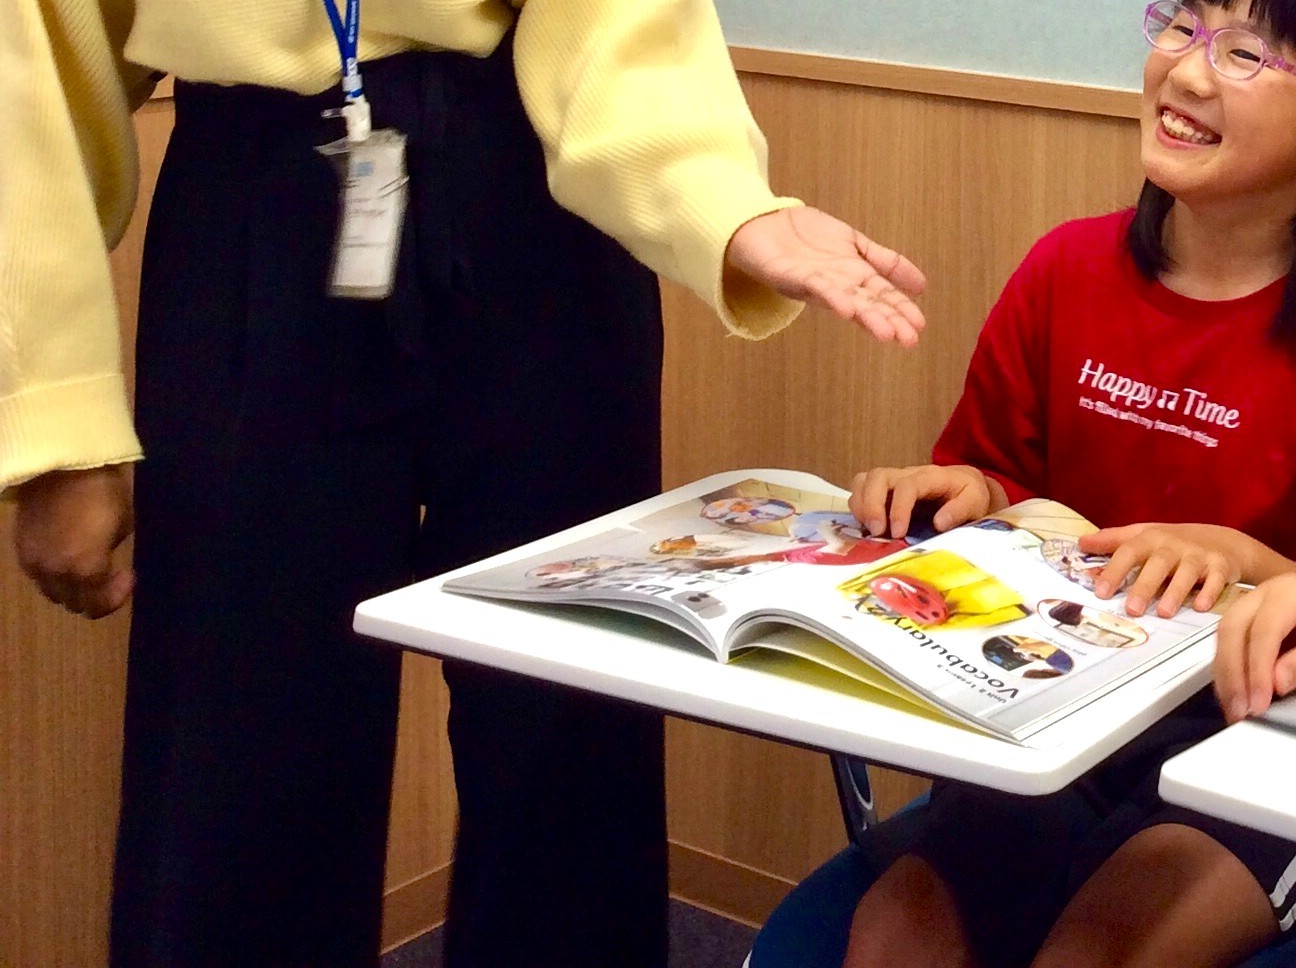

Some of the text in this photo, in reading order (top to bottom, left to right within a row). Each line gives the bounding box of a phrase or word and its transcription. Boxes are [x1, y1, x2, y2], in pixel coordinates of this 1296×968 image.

[1078, 358, 1158, 410] Happy
[1183, 388, 1241, 429] Time
[892, 617, 1020, 700] Vocabulary
[945, 667, 977, 689] Lesson
[987, 691, 1007, 705] Unit
